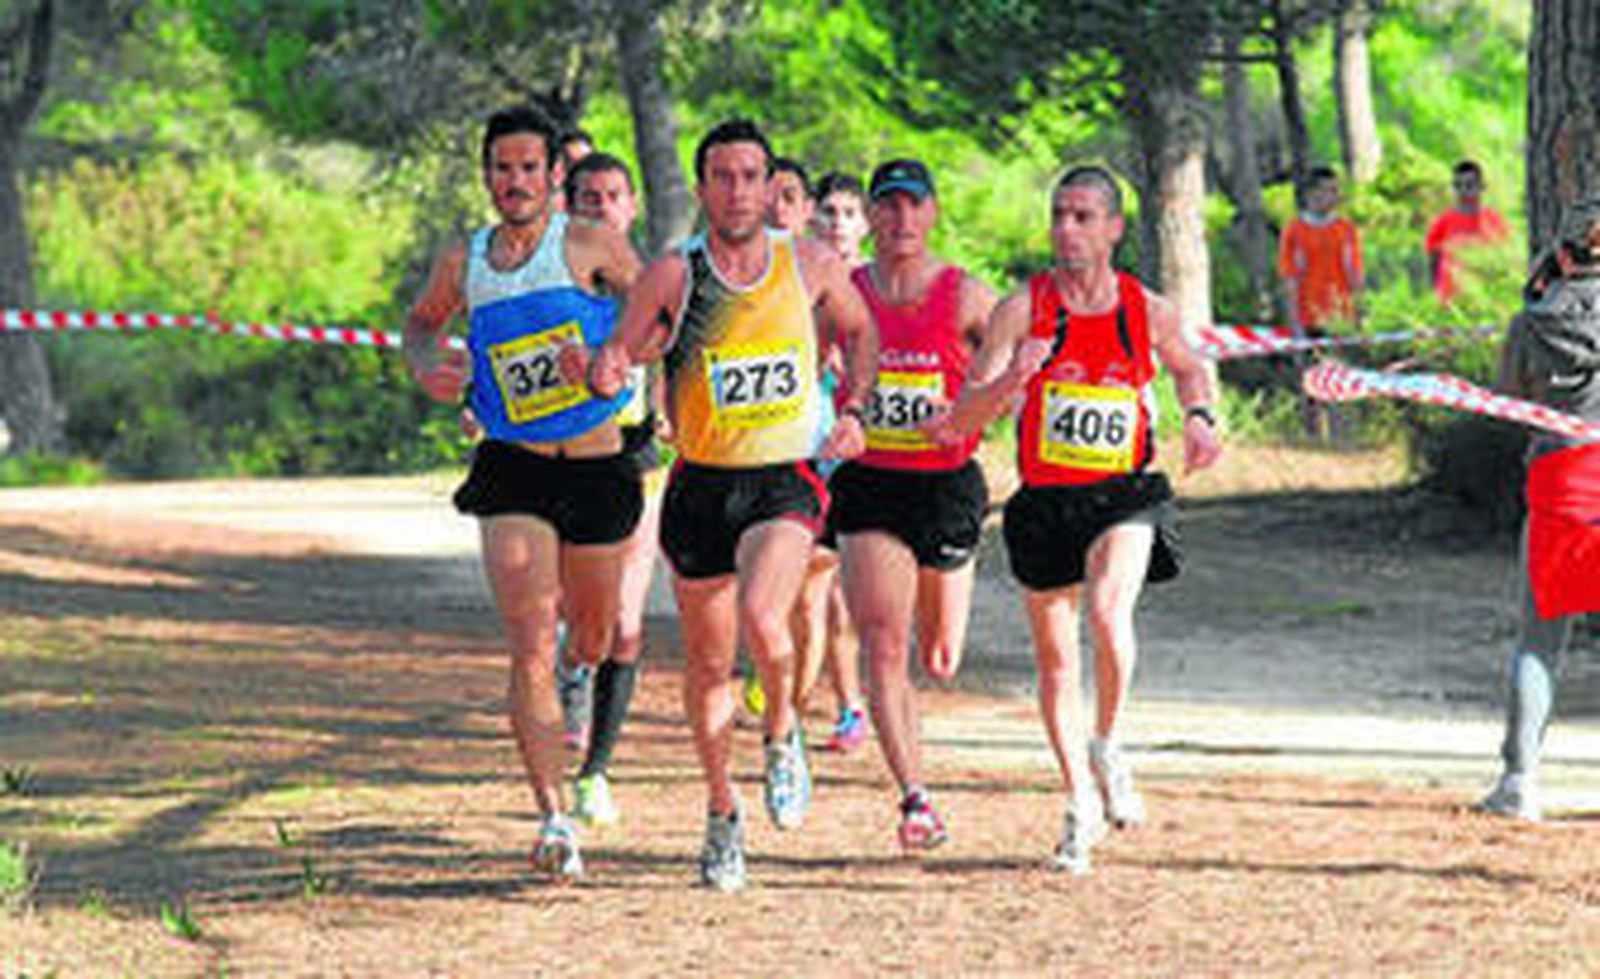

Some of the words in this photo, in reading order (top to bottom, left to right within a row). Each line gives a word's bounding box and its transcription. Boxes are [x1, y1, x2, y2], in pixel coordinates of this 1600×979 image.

[507, 353, 561, 396] 32
[724, 360, 799, 404] 273
[1053, 406, 1127, 446] 406
